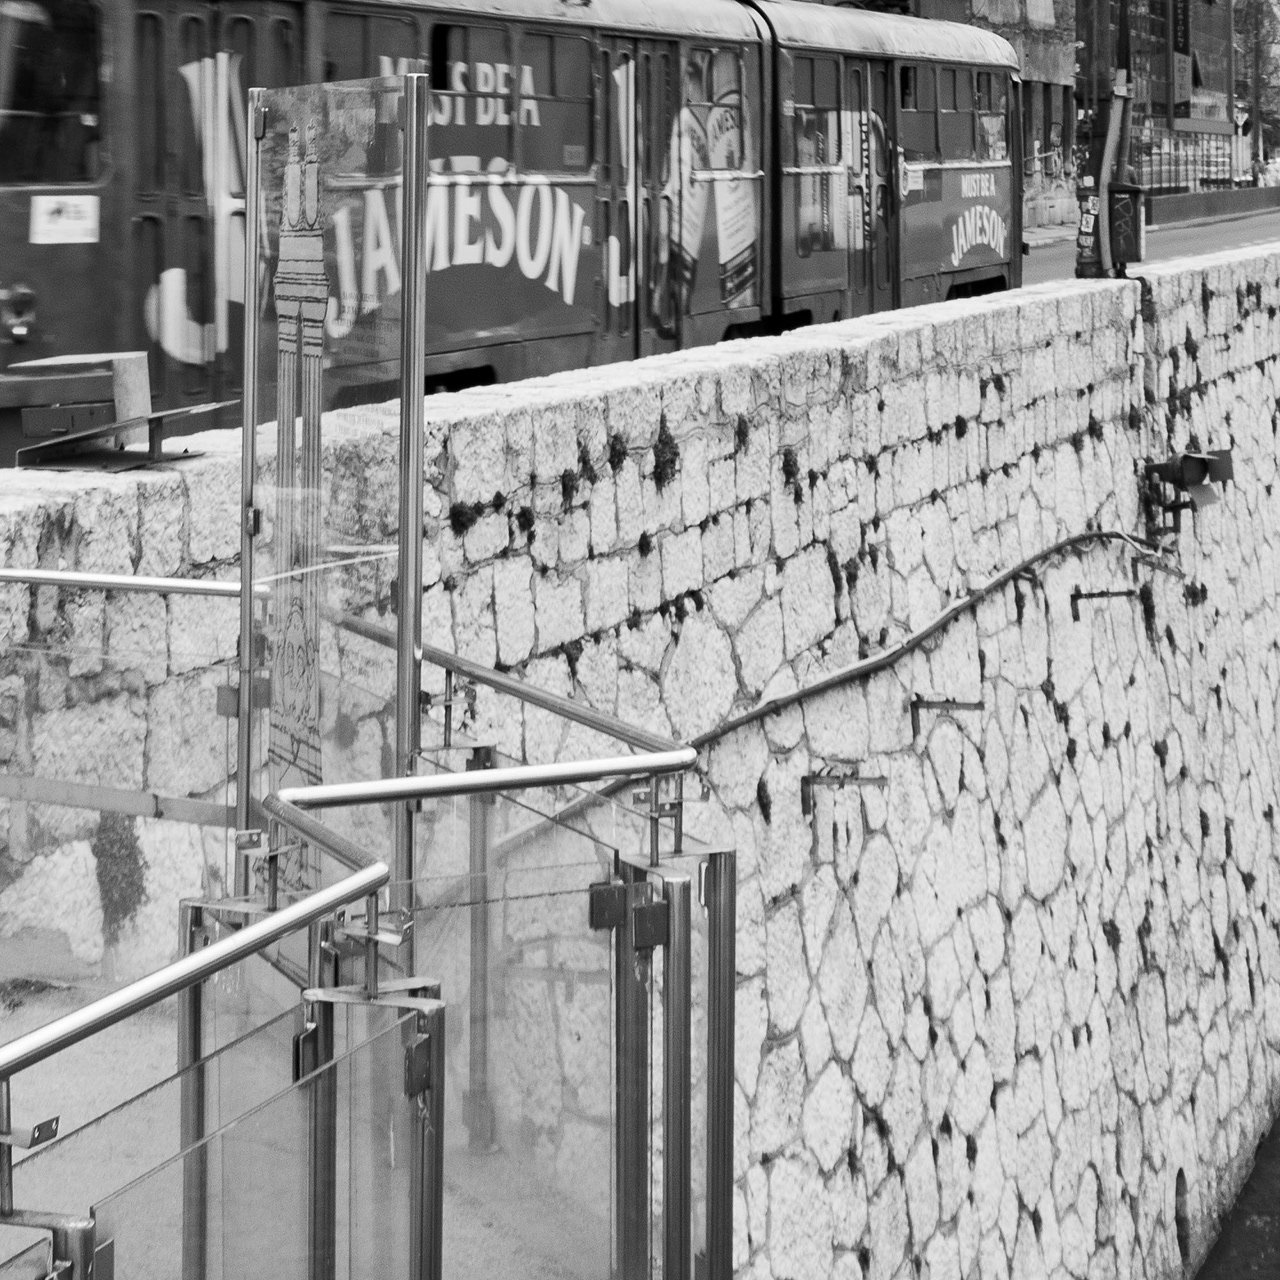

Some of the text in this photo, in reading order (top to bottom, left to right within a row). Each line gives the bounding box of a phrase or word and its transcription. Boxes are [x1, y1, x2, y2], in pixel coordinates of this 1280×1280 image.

[475, 62, 511, 126] BE
[519, 64, 541, 127] A
[961, 173, 996, 198] MUST BE A
[951, 205, 1006, 267] JAMESON
